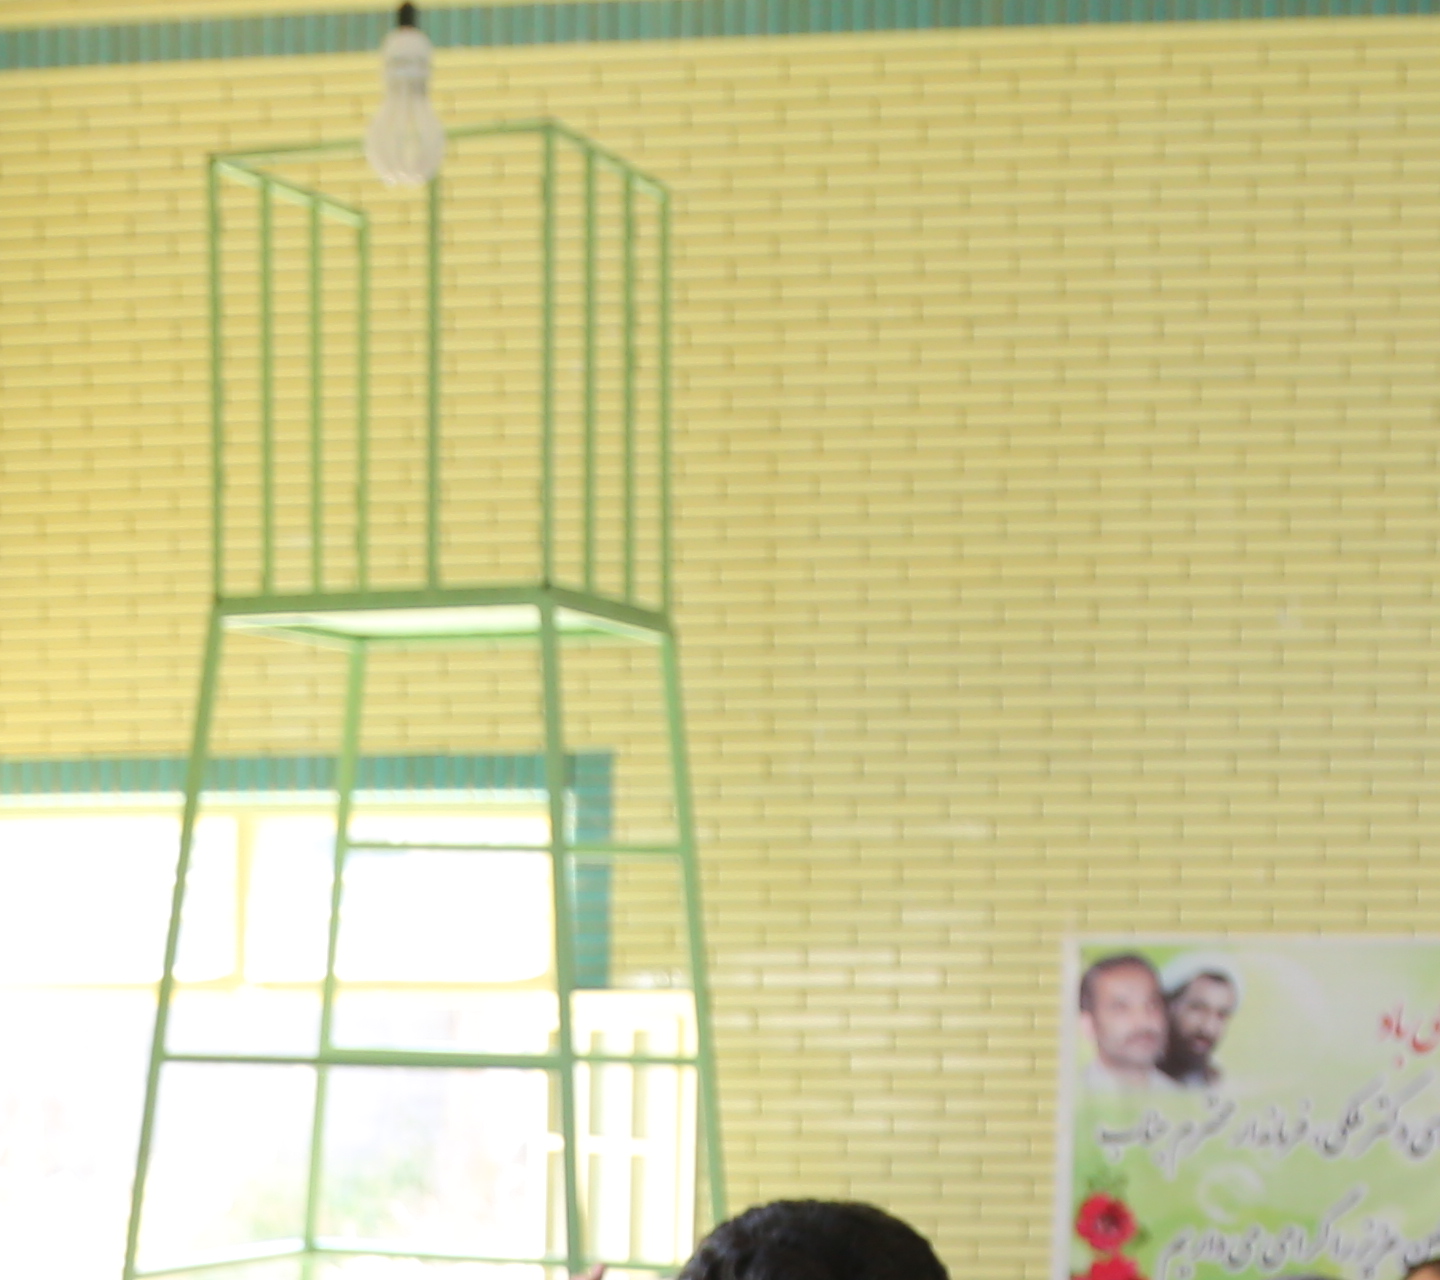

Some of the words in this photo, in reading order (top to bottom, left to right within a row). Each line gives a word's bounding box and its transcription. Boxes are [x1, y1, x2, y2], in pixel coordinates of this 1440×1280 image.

[1377, 1002, 1405, 1069] باد
[1101, 1111, 1169, 1163] جناب
[1169, 1094, 1236, 1178] محترم
[1351, 1070, 1434, 1157] دکتر
